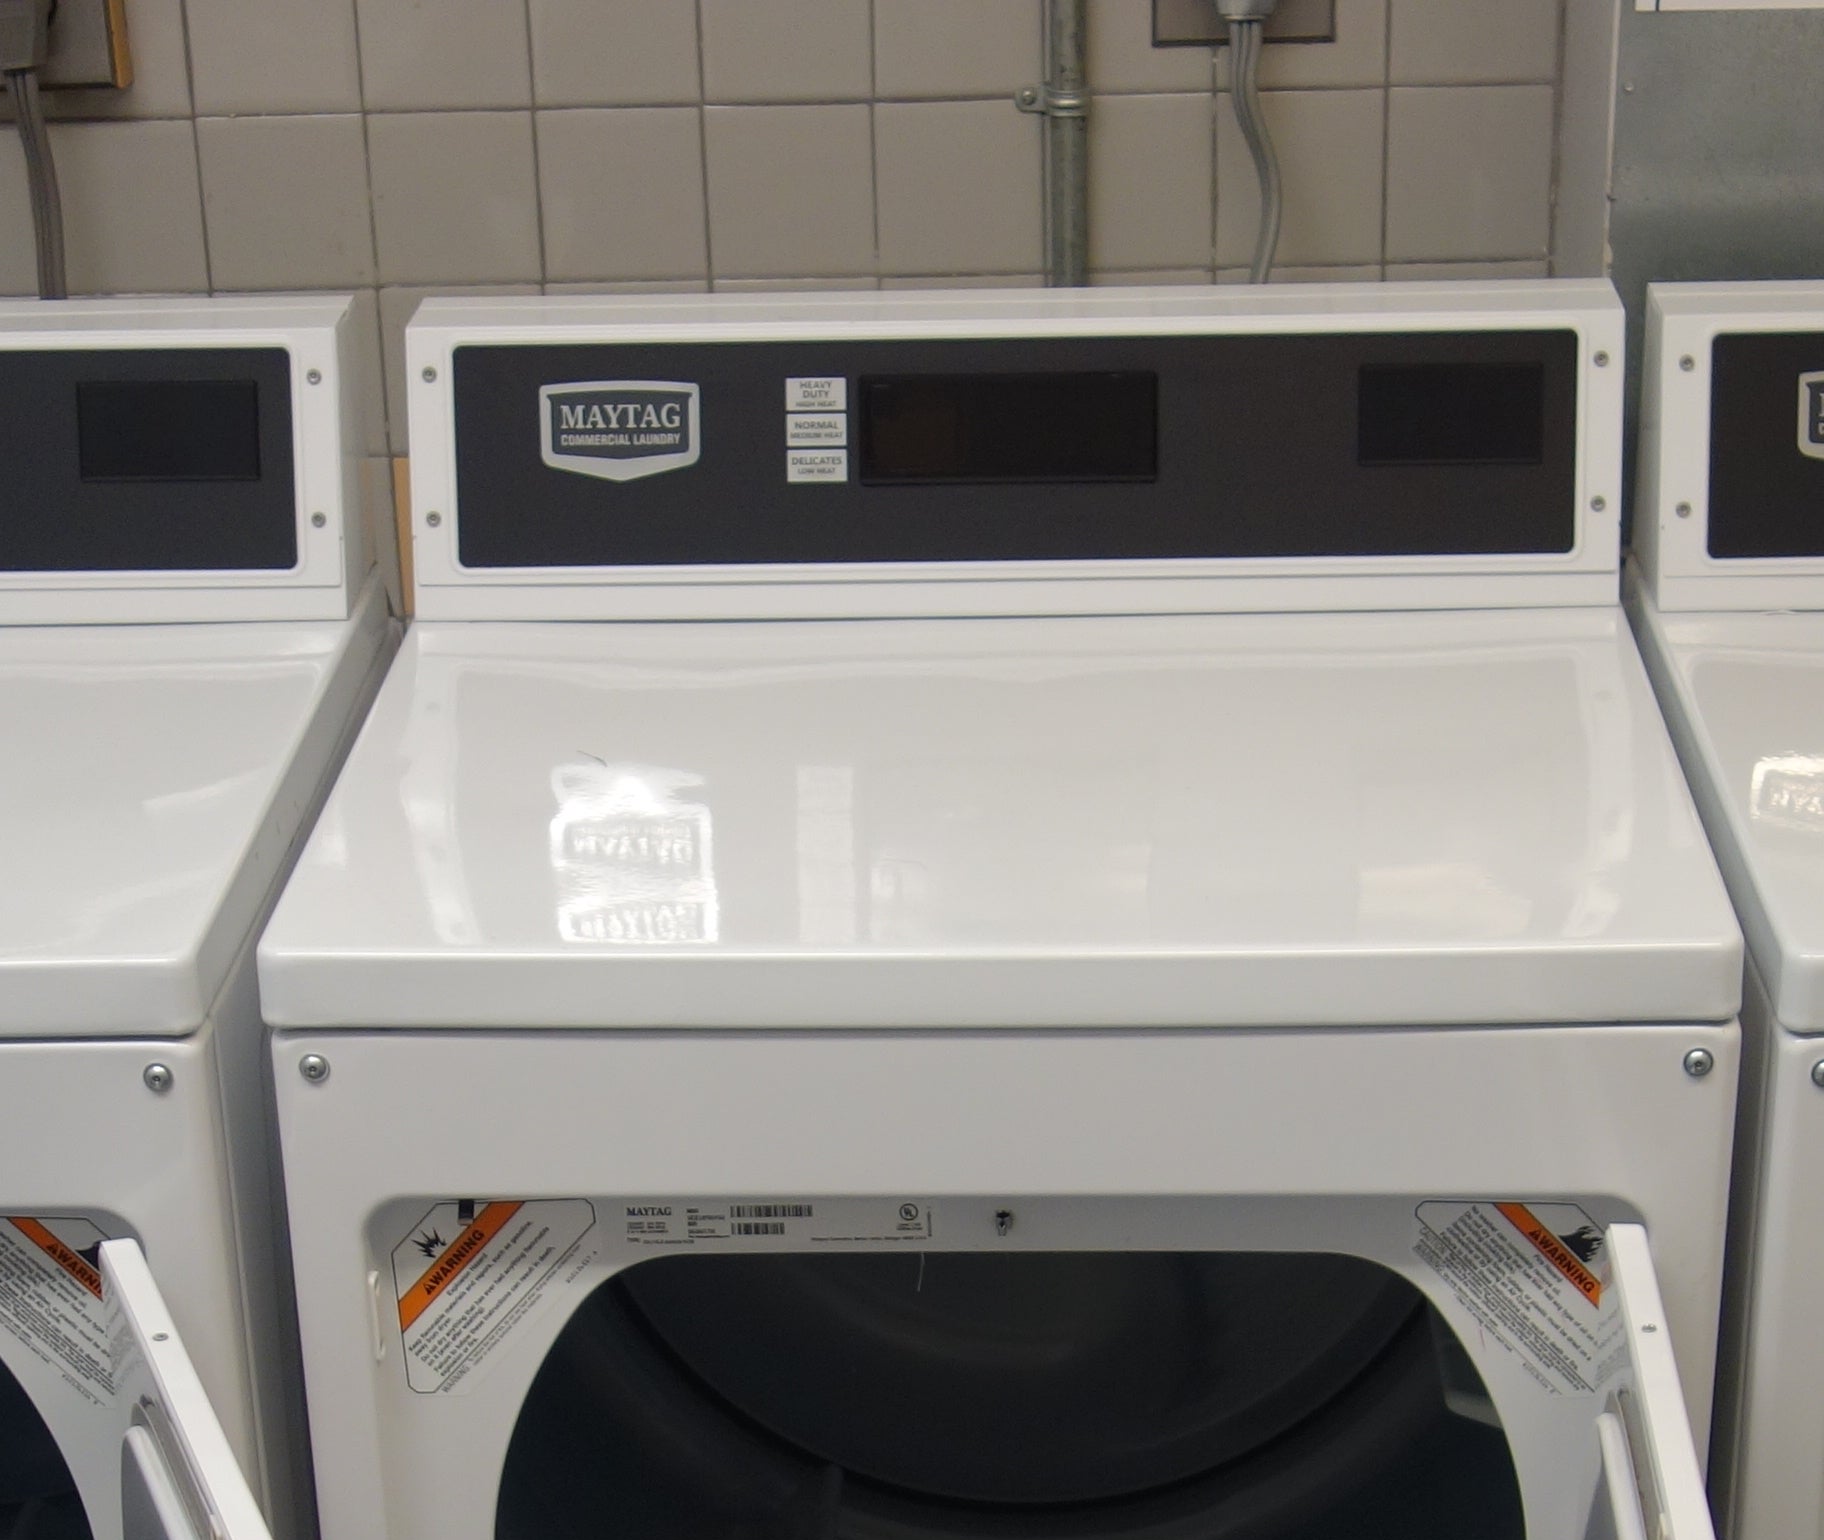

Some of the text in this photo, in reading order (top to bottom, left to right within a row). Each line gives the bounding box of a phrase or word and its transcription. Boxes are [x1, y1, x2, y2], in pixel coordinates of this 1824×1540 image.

[799, 381, 832, 389] HEAVY
[802, 389, 830, 399] DUTY
[560, 402, 681, 429] MAYTAG
[794, 421, 839, 430] NORMAL
[560, 432, 681, 446] COMMERCIAL LAUNDRY
[791, 456, 842, 466] DELICATES
[626, 1206, 672, 1216] MAYTAG
[430, 1228, 484, 1285] WARNING
[1536, 1235, 1595, 1293] WARNING
[56, 1249, 104, 1293] WARNI
